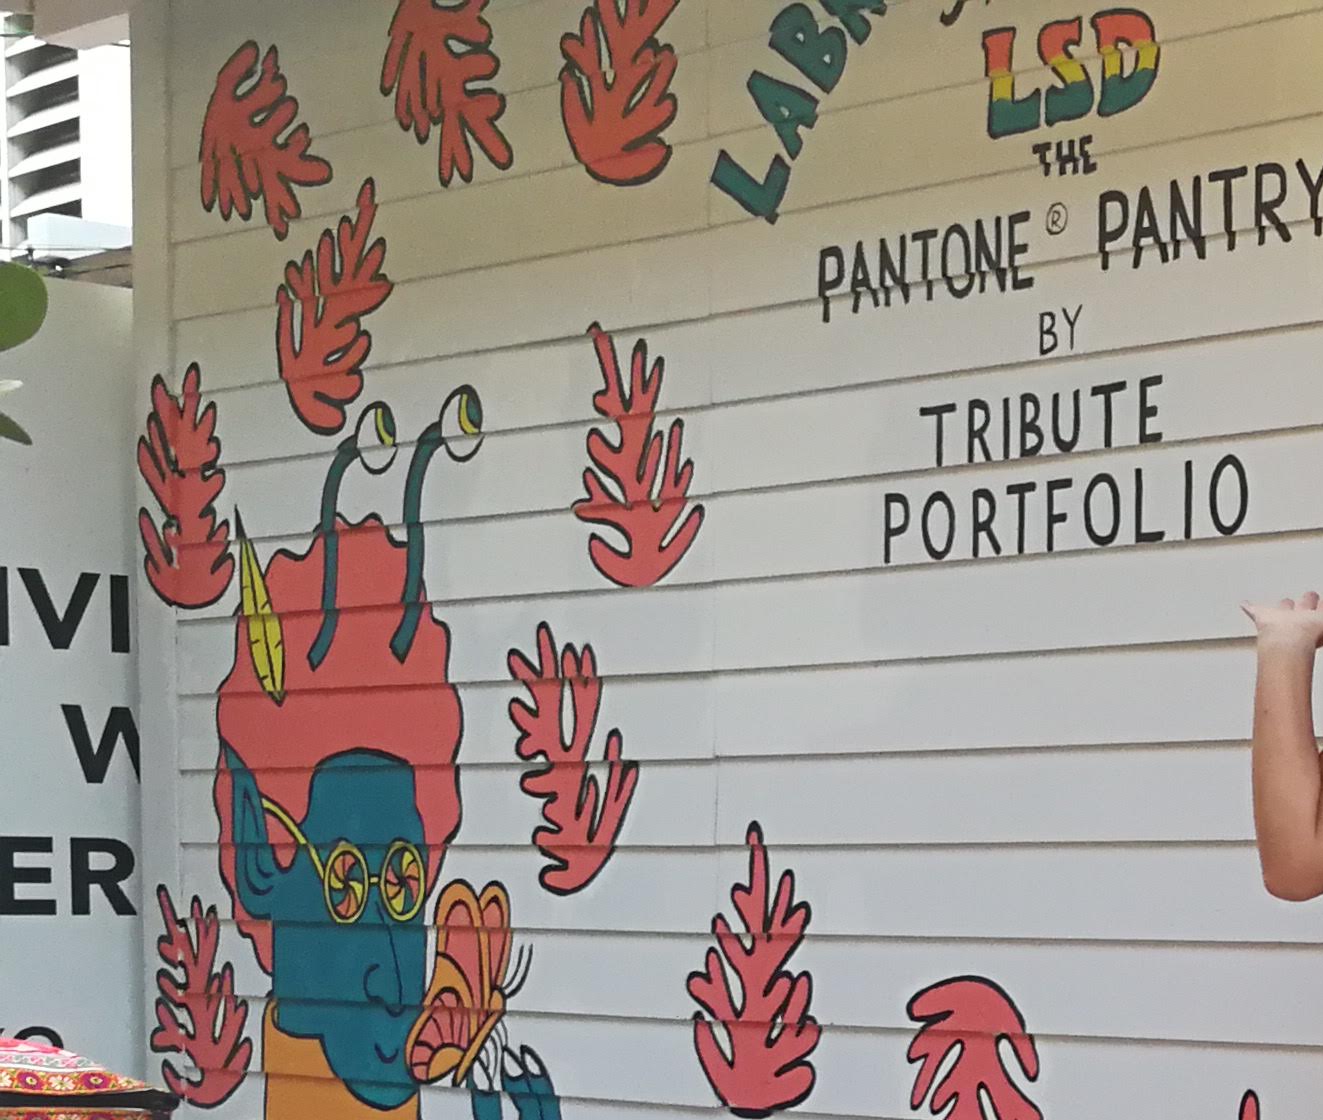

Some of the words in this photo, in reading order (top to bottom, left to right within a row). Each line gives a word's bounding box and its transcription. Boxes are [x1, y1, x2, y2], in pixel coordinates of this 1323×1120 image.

[982, 8, 1160, 139] LSD
[1032, 134, 1098, 176] THE
[1037, 306, 1083, 356] BY
[919, 375, 1164, 468] TRIBUTE
[881, 455, 1249, 564] PORTFOLIO
